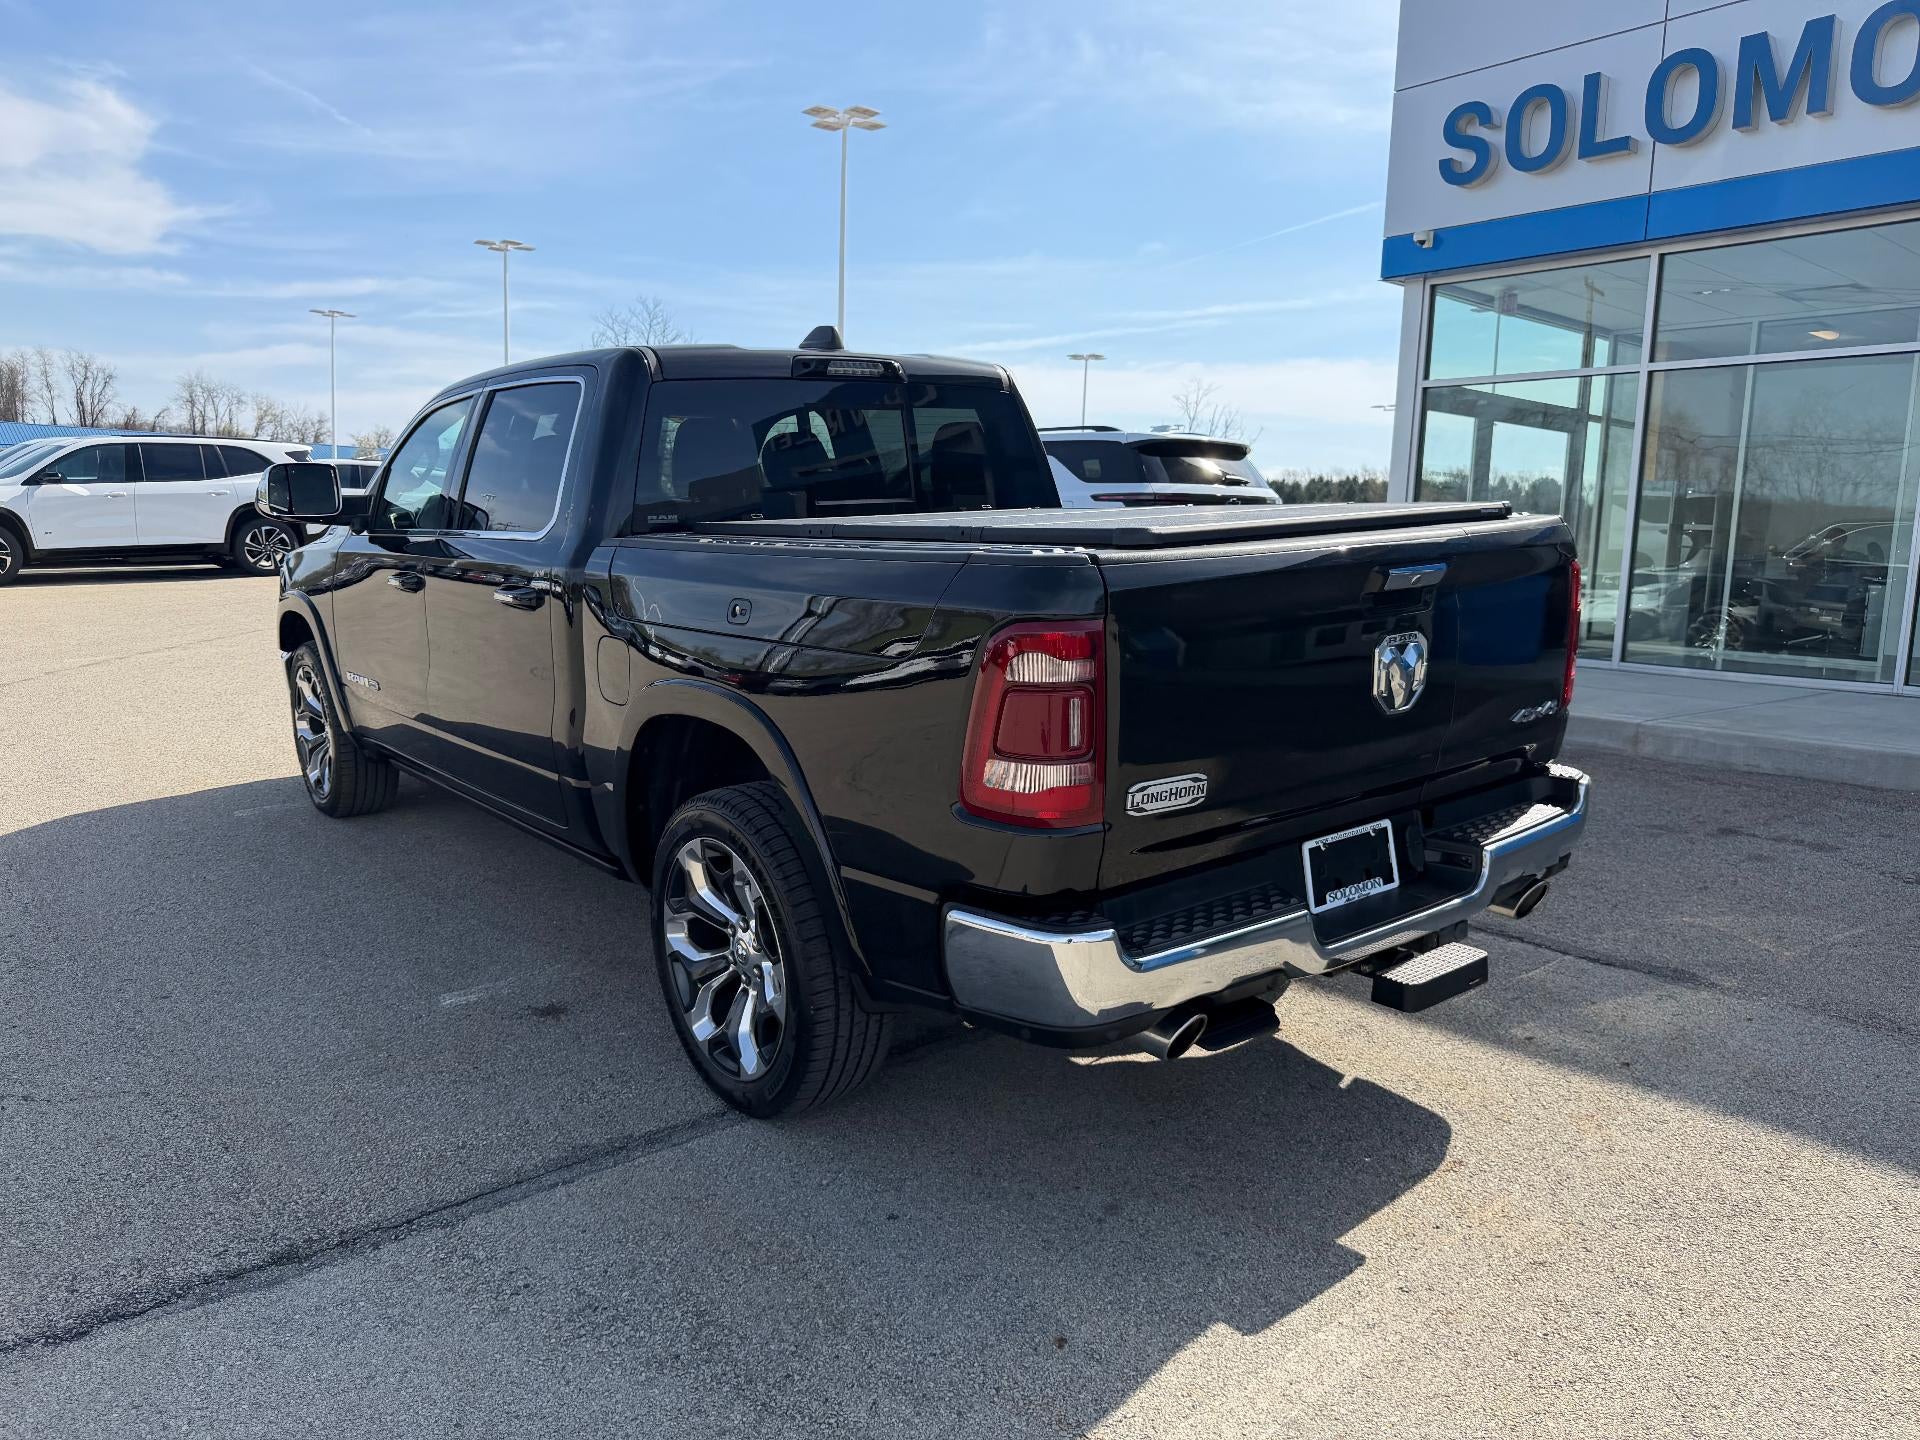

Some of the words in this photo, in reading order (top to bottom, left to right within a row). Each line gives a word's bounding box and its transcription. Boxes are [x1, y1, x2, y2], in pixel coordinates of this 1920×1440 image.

[1439, 0, 1920, 187] SOLOMO
[1388, 632, 1418, 645] RAM
[1328, 879, 1382, 902] SOLOMON
